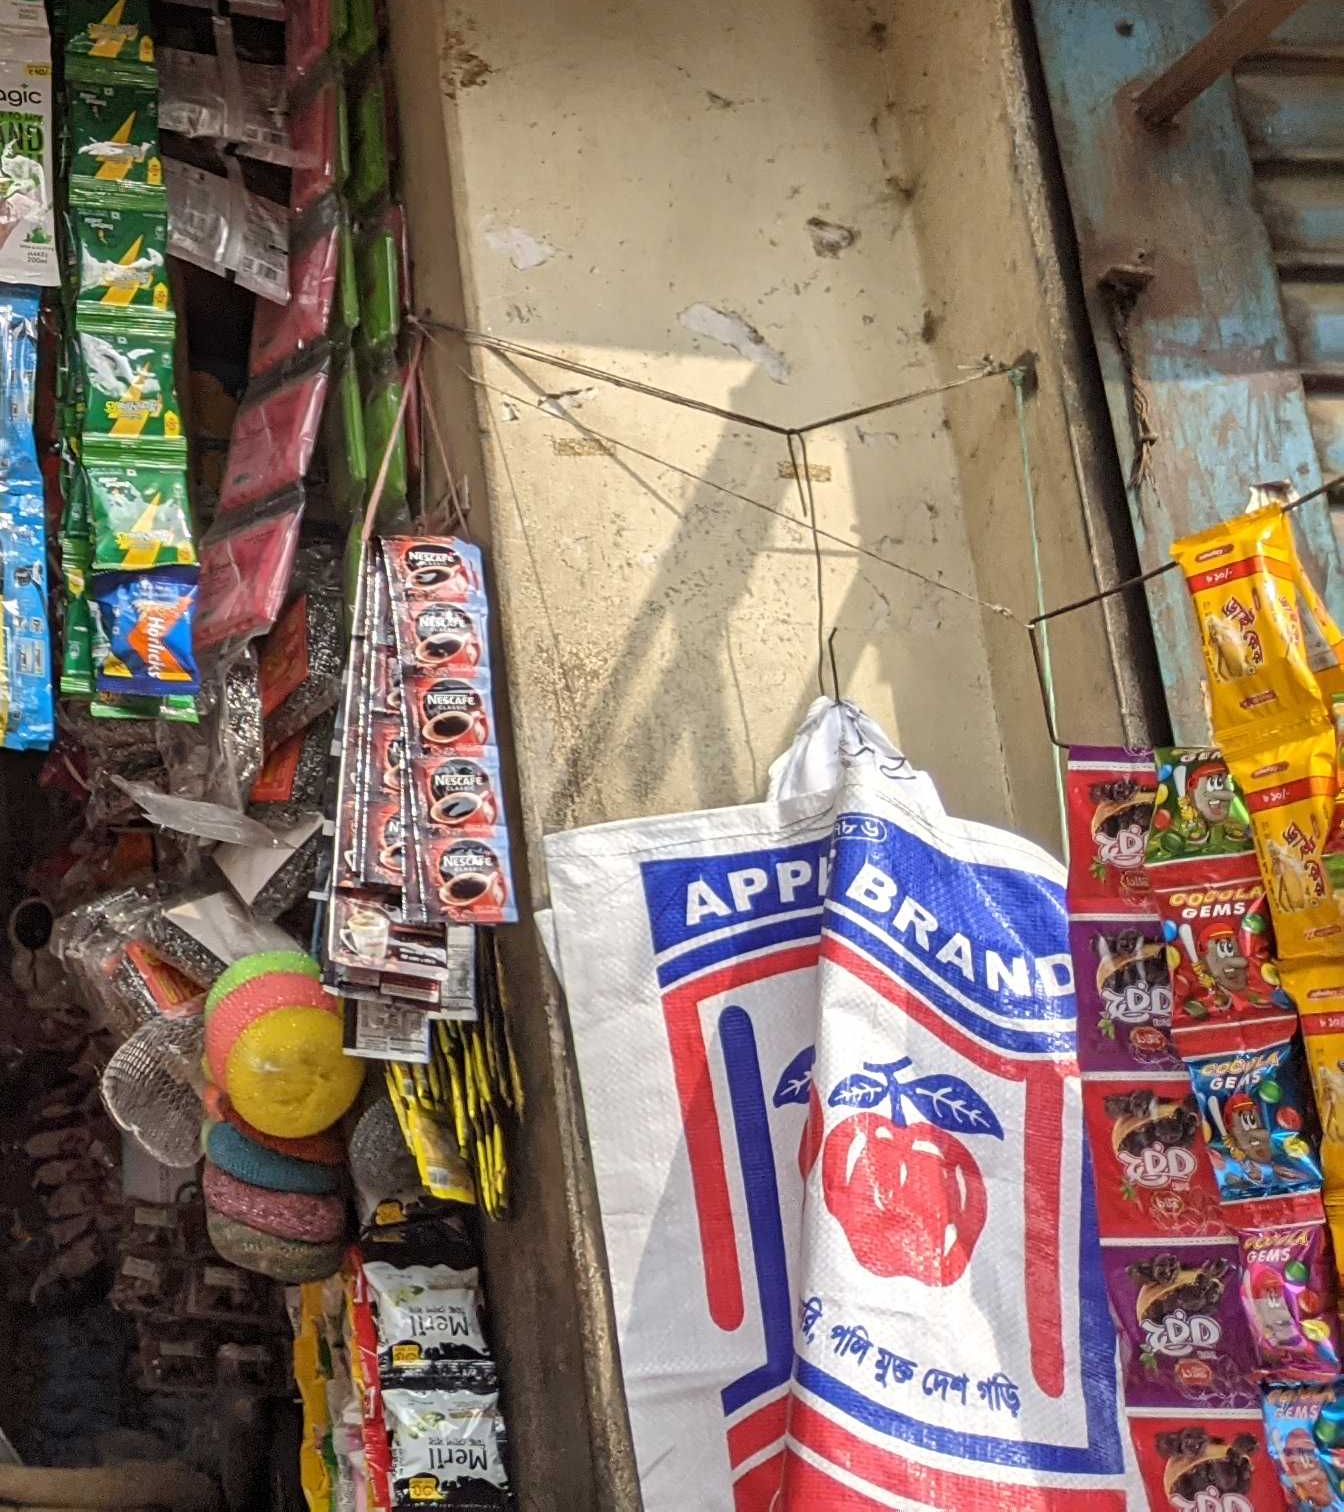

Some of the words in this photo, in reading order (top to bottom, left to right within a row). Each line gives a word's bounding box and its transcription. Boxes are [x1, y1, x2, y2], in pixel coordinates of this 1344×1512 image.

[147, 616, 165, 680] Horlicks
[1181, 902, 1247, 920] GEMS
[845, 862, 1076, 998] BRAND
[1200, 1052, 1279, 1077] COCOLA
[1210, 1074, 1262, 1091] GEMS
[1246, 1248, 1292, 1264] GEMS
[410, 1314, 470, 1337] Meril
[830, 1324, 873, 1366] পলি
[875, 1346, 918, 1388] মুক্ত
[922, 1367, 970, 1406] দেশ
[976, 1372, 1021, 1419] গড়ি
[429, 1447, 489, 1471] Meril
